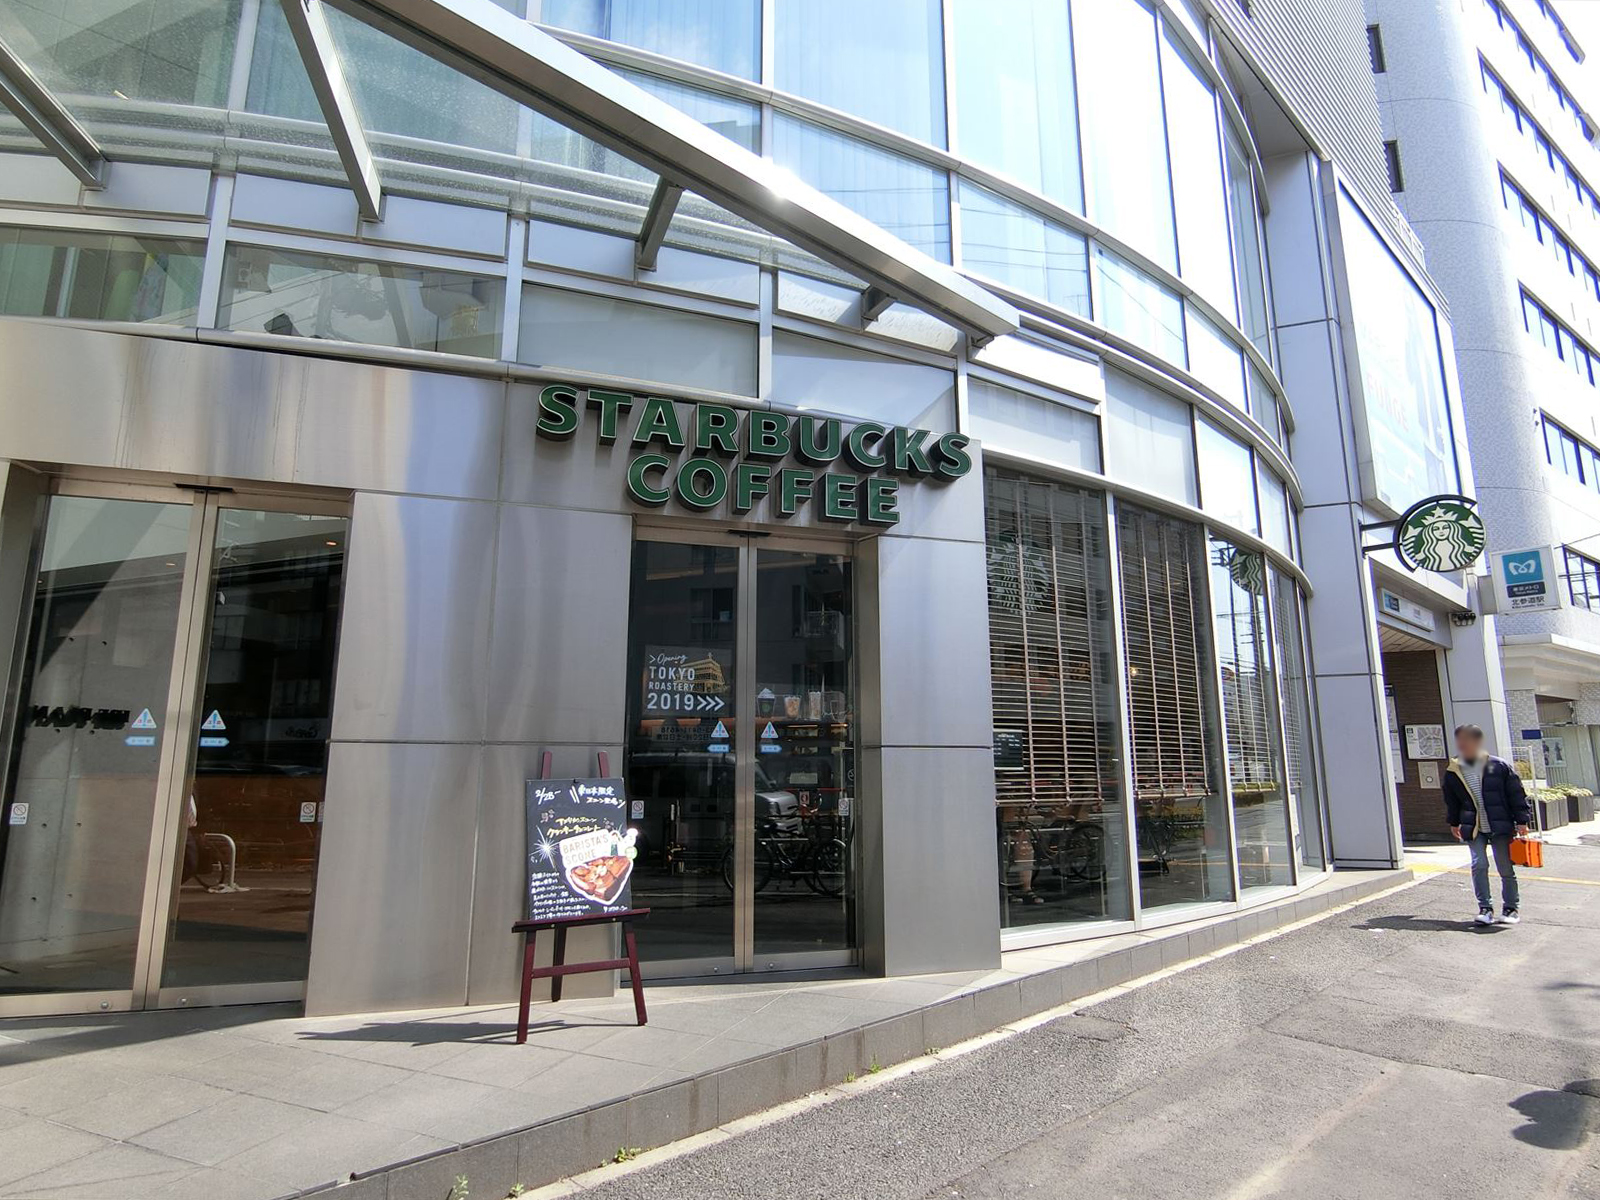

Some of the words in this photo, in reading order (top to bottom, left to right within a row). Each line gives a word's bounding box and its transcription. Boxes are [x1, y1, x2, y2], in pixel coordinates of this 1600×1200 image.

[536, 384, 972, 482] STARBUCKS
[626, 452, 901, 528] COFFEE
[657, 653, 688, 666] Opening
[649, 666, 696, 681] TOKYO
[648, 681, 696, 692] ROASTERY
[647, 692, 694, 711] 2019
[562, 833, 609, 854] BARISTA'S
